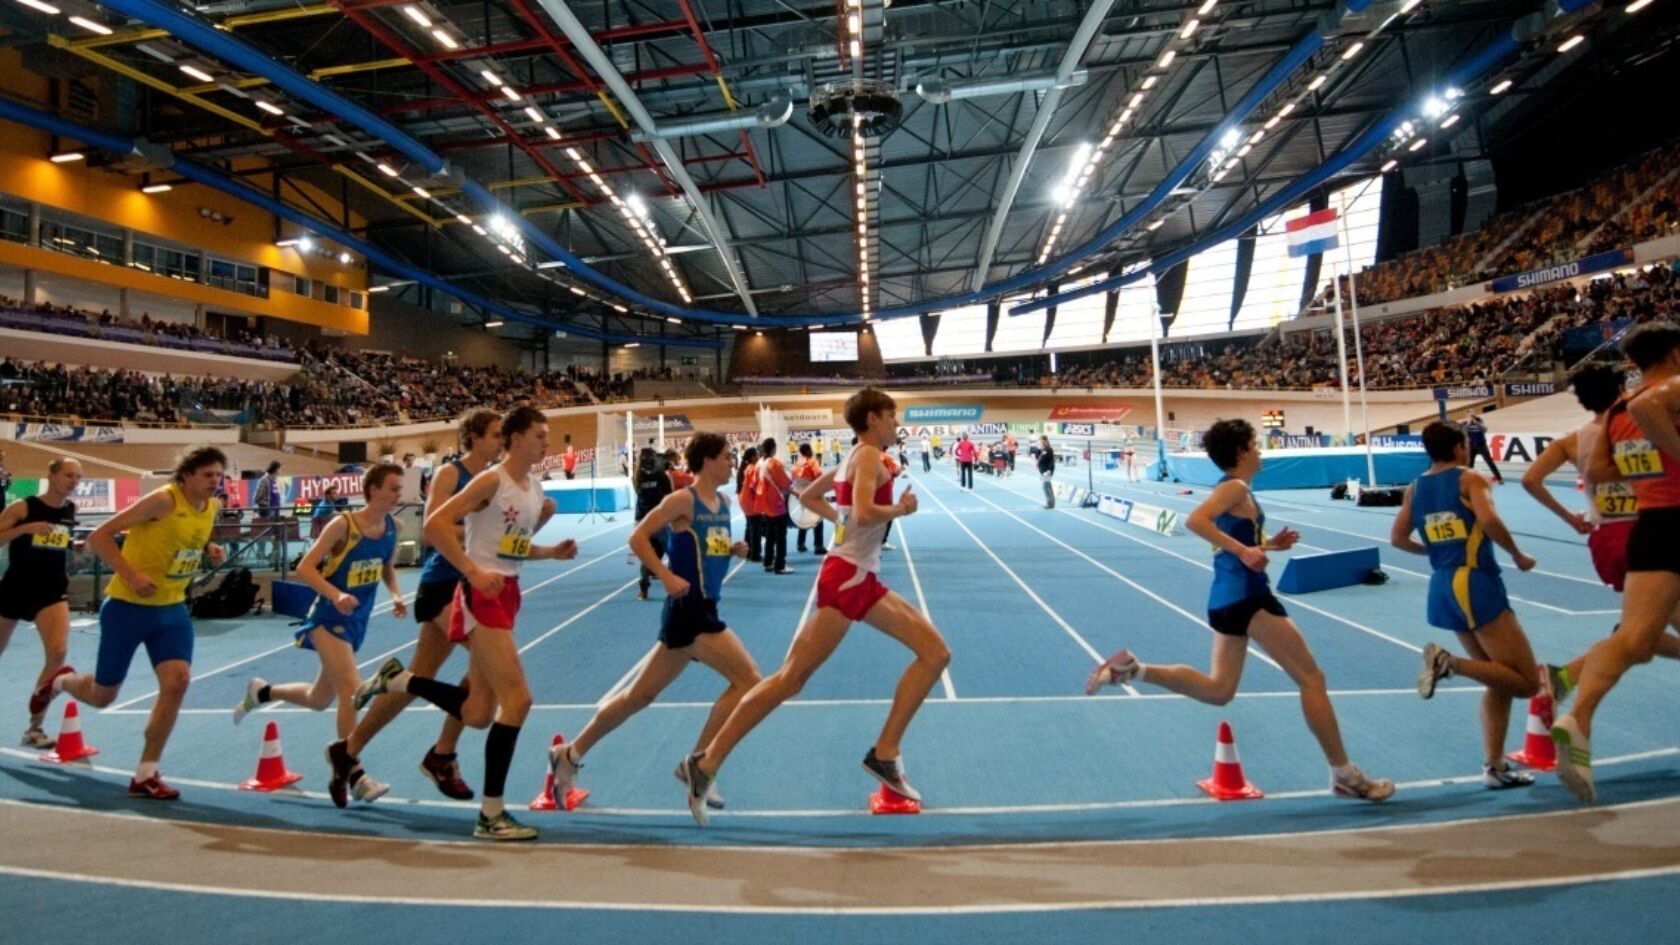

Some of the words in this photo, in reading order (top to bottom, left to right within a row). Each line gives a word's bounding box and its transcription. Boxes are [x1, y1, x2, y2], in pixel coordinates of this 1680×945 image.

[1517, 262, 1579, 288] SHIMANO
[1447, 385, 1489, 398] SHIMANO
[909, 407, 977, 417] SHIMANO
[1624, 453, 1651, 473] 176
[1605, 495, 1637, 512] 377
[1432, 523, 1455, 540] 115
[357, 568, 378, 584] 121
